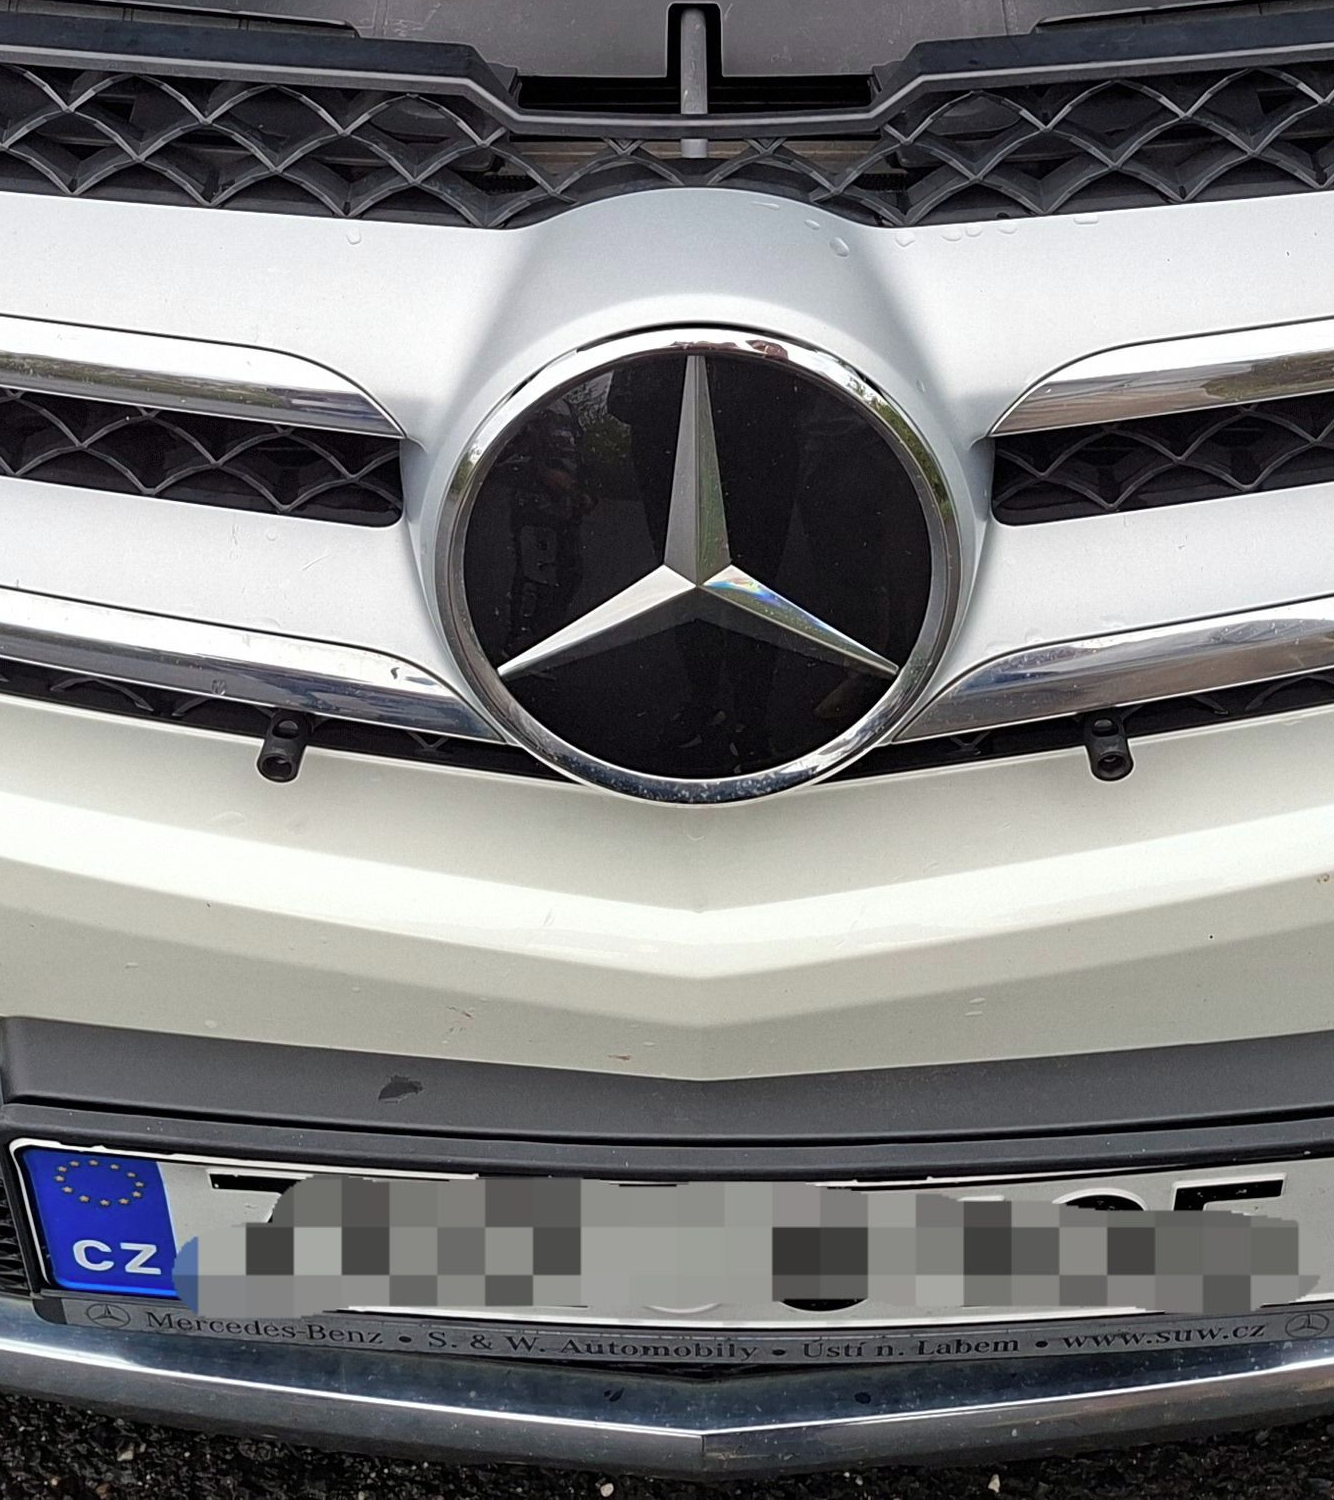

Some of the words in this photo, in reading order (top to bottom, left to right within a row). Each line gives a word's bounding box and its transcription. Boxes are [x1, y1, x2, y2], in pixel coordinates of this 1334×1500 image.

[72, 1238, 162, 1275] CZ
[145, 1311, 385, 1346] Mercedes-Benz
[427, 1330, 458, 1349] S.
[470, 1332, 495, 1350] &
[505, 1334, 547, 1354] W.
[558, 1338, 759, 1363] Automobily
[801, 1337, 867, 1359] Ústí
[874, 1341, 906, 1358] n.
[914, 1335, 1021, 1357] Labem
[1062, 1320, 1267, 1349] www.suw.cz
